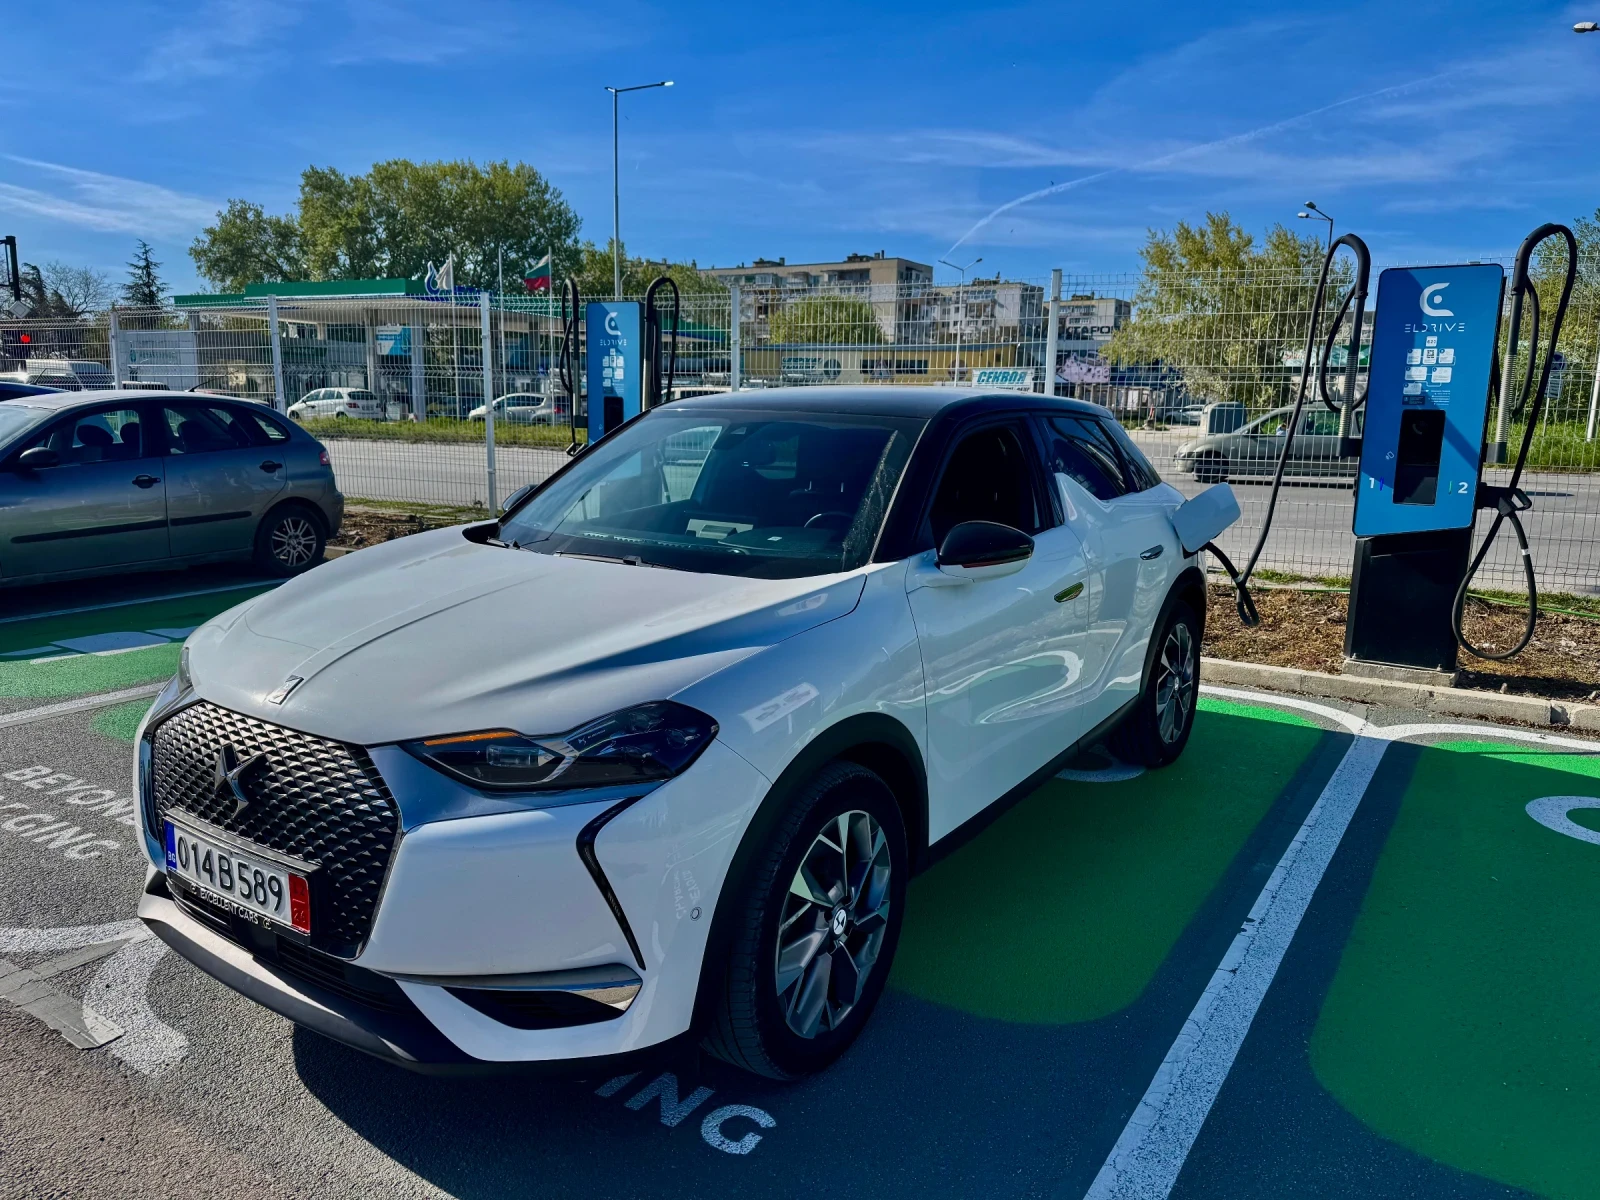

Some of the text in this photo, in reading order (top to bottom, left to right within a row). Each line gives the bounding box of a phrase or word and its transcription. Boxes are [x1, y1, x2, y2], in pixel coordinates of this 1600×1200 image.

[1404, 322, 1466, 333] ELDRIVE
[599, 338, 627, 346] ELDRIVE
[1368, 477, 1375, 489] 1
[1457, 481, 1469, 494] 2
[168, 850, 176, 864] BG
[177, 835, 283, 912] 014B589
[200, 887, 259, 925] EXCELLENT CARS
